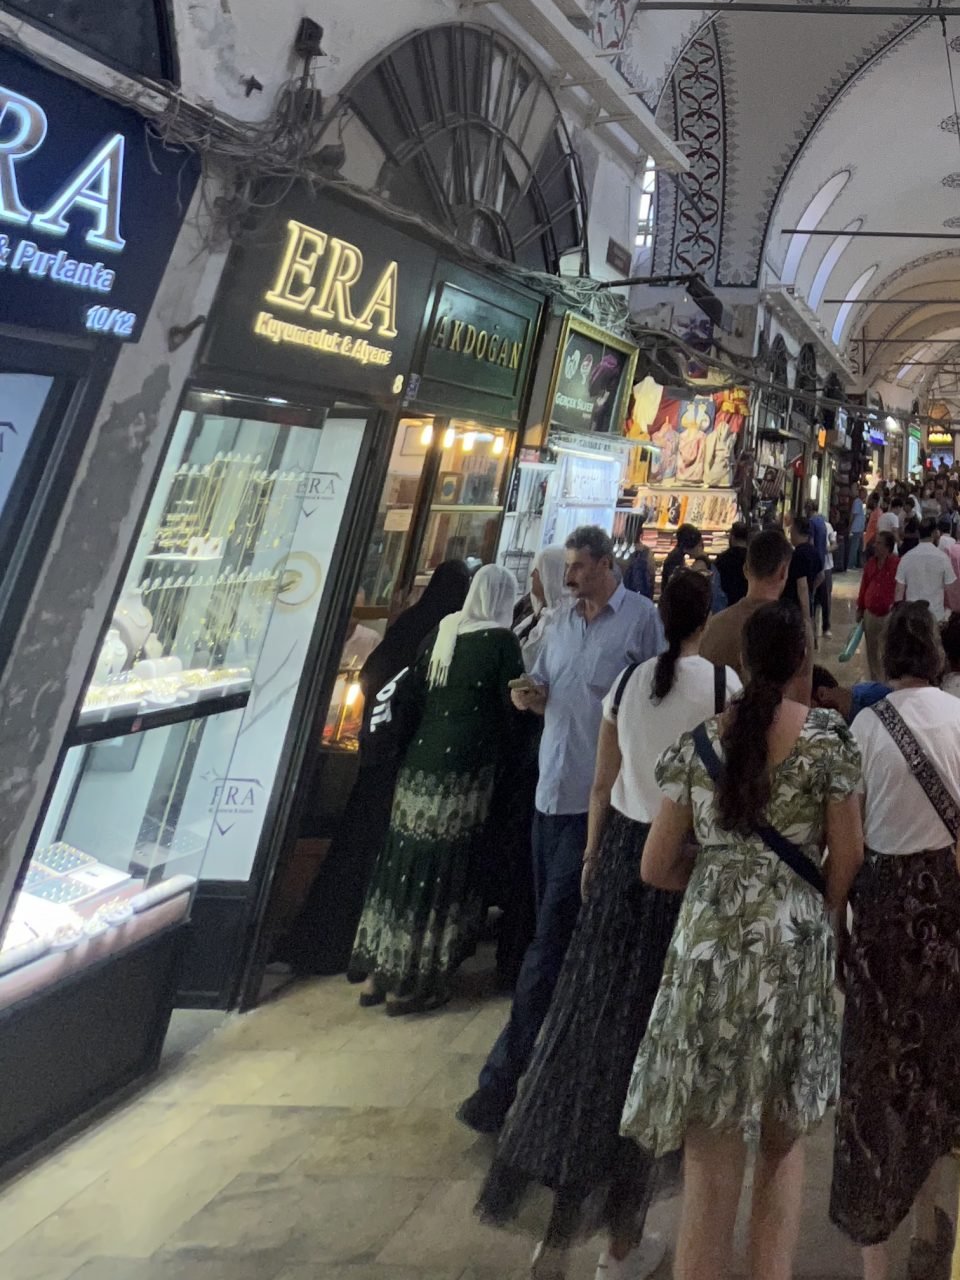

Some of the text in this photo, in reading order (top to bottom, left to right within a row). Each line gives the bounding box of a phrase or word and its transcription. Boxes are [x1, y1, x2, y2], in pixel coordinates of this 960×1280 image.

[265, 220, 398, 337] ERA
[86, 305, 136, 335] 10/12
[340, 335, 353, 356] &
[393, 374, 404, 394] 8
